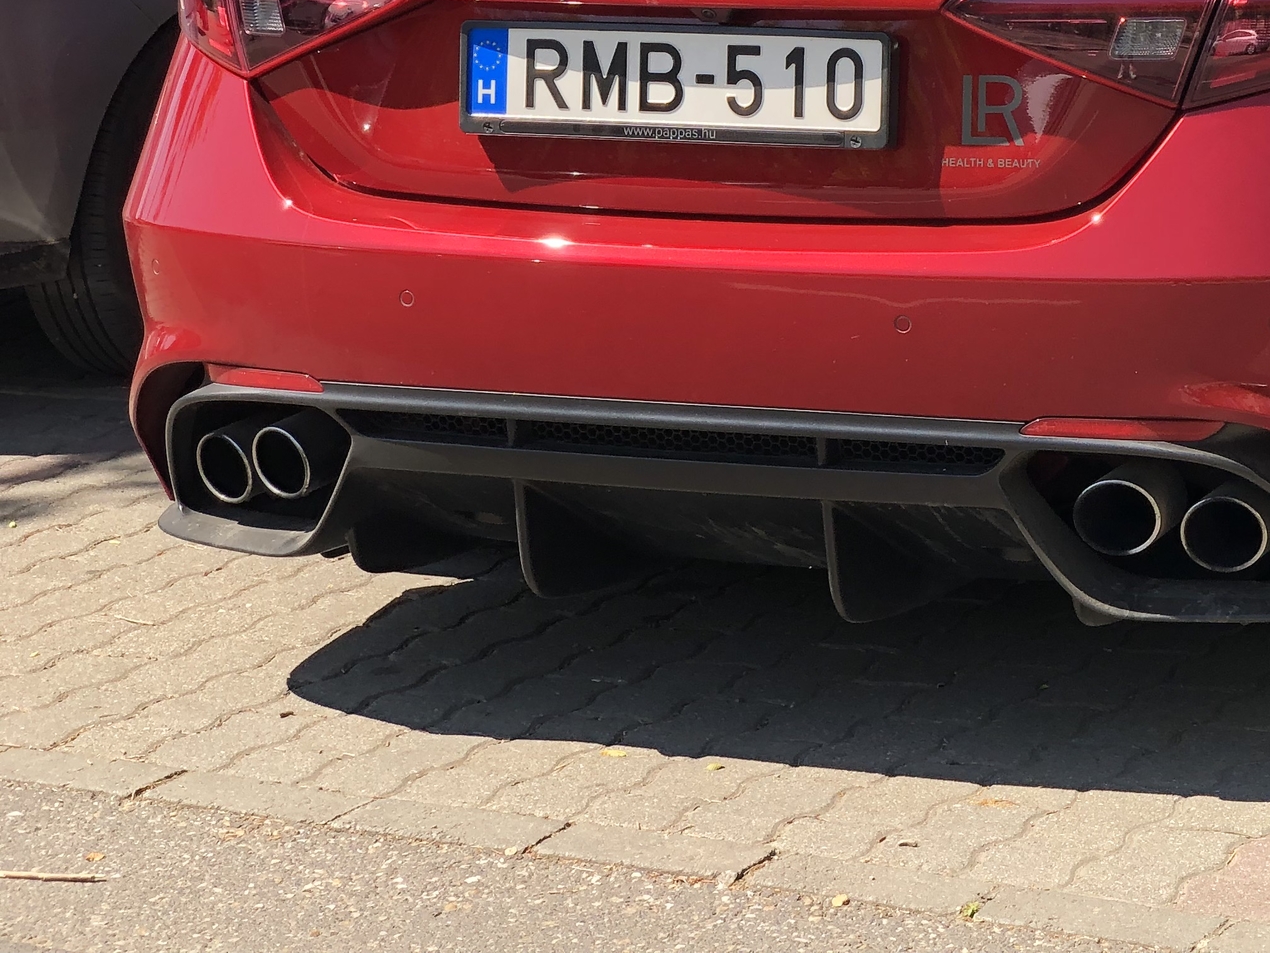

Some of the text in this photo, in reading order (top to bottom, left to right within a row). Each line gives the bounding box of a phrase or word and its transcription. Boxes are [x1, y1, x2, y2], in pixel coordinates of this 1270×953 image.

[477, 79, 496, 104] H
[525, 38, 864, 120] RMB-510
[961, 74, 1025, 146] LR
[623, 126, 716, 140] www.pappas.hu
[941, 157, 1041, 169] HEALTH & BEAUTY
